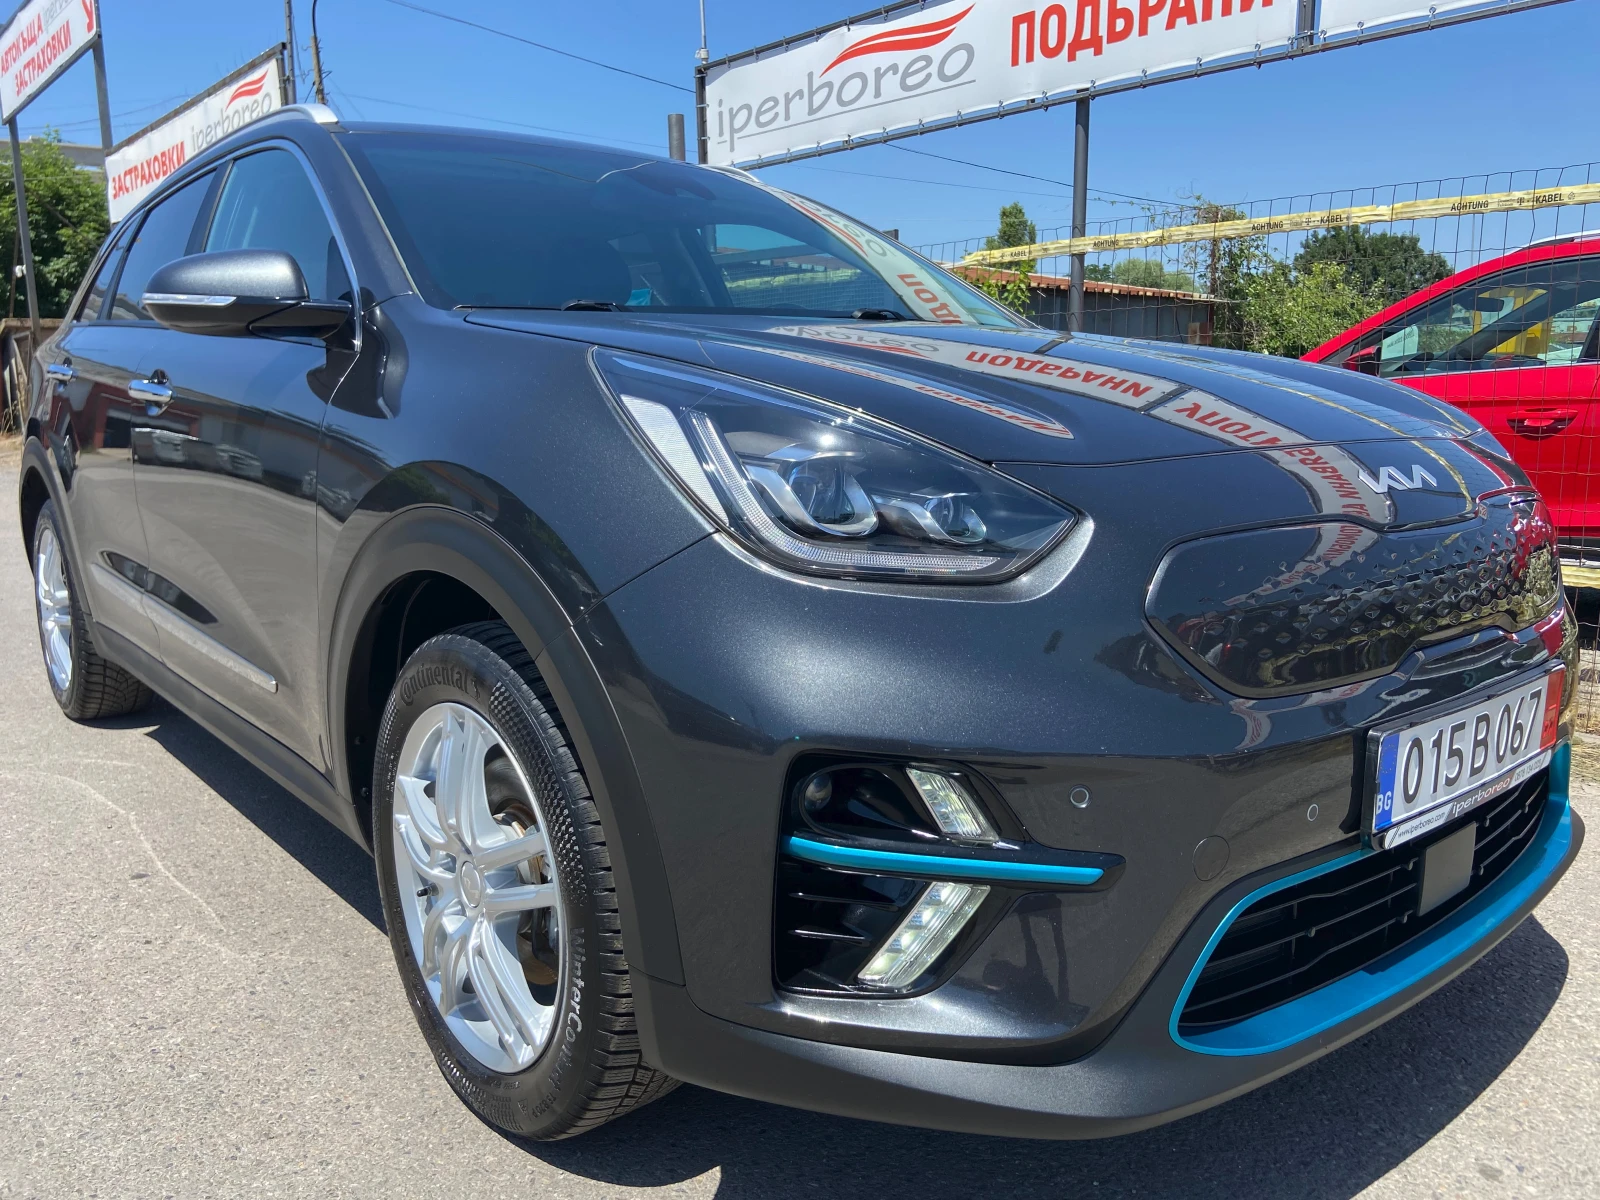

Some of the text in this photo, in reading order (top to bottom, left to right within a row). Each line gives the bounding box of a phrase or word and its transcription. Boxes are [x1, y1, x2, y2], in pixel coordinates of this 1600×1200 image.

[1011, 0, 1274, 67] ПОДБРА
[15, 19, 72, 97] ЗАСТРАХОВКИ
[717, 43, 975, 152] iperboreo
[192, 92, 272, 152] iperboreo
[112, 141, 185, 200] ЗАСТРАХОВКИ
[1251, 221, 1284, 232] ACHTUNG
[1320, 215, 1344, 225] KABEL
[1450, 200, 1489, 211] ACHTUNG
[1535, 193, 1565, 204] KABEL
[1093, 240, 1120, 248] ACHTUNG
[400, 663, 469, 707] Continental
[1377, 790, 1392, 814] BG
[1453, 777, 1511, 818] iperboreo
